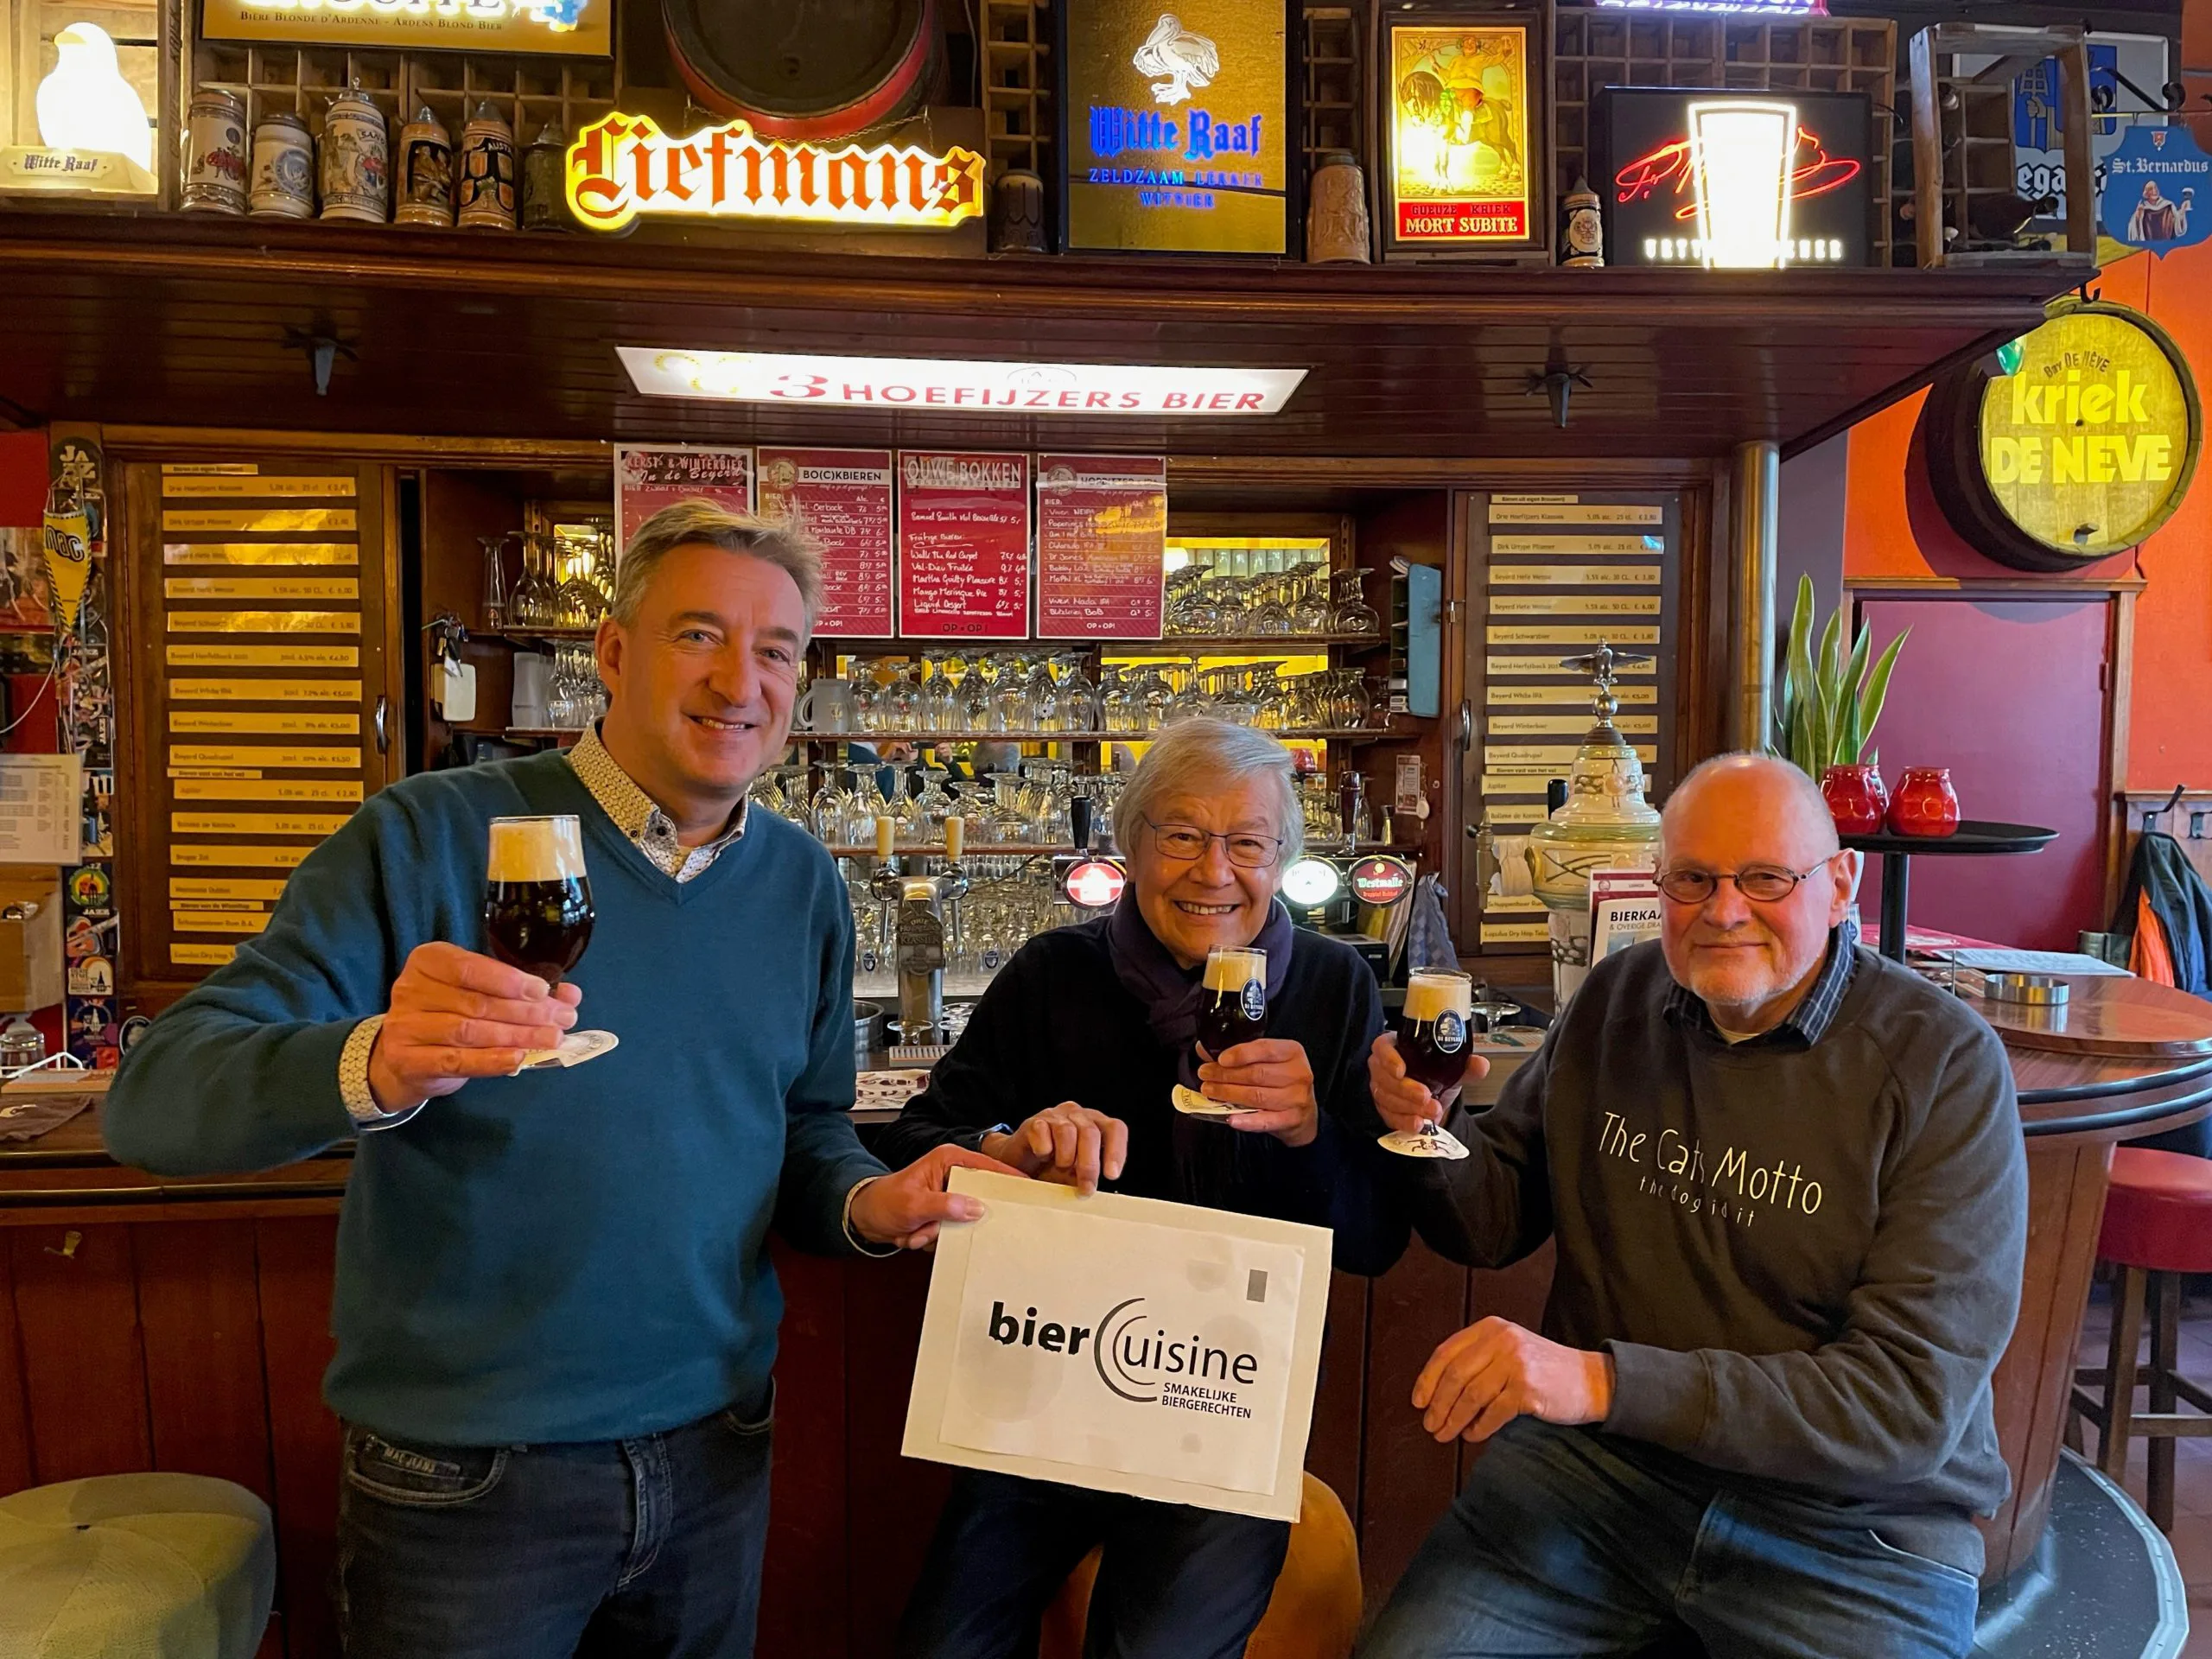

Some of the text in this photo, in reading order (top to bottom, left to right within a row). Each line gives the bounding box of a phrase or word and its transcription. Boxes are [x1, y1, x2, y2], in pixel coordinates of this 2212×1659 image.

[274, 11, 315, 22] BLONDE
[393, 16, 434, 28] ARDENS
[438, 19, 474, 29] BLOND
[479, 20, 503, 31] BIER
[1090, 105, 1262, 161] Witte Raaf
[24, 154, 99, 173] Witte Raaf
[573, 119, 983, 219] Liefmans
[1089, 168, 1263, 187] ZELDZAAM LEKKER
[1411, 203, 1511, 215] GUEUZE KRIEK
[1405, 216, 1518, 234] MORT SUBITE
[770, 374, 1265, 410] 3 HOEFIJZERS BIER
[2012, 370, 2150, 424] kriek
[668, 459, 675, 469] &
[1991, 435, 2172, 485] DE NEVE
[664, 470, 682, 480] de
[690, 467, 741, 484] Beyerd
[803, 470, 881, 481] BO(C)KBIEREN
[959, 461, 1021, 482] BOKKEN
[932, 550, 944, 559] The
[966, 575, 996, 584] Pleasure
[912, 588, 938, 601] Mango
[939, 588, 975, 601] Meringue
[942, 623, 958, 632] OP
[1616, 922, 1646, 931] OVERIGE
[1599, 1111, 1647, 1163] The
[1711, 1147, 1822, 1214] Motto
[1639, 1175, 1663, 1198] the
[1671, 1185, 1701, 1213] dog
[1737, 1207, 1754, 1227] it
[1164, 1382, 1237, 1404] SMAKELIJKE
[1161, 1395, 1251, 1419] BIERGERECHTEN
